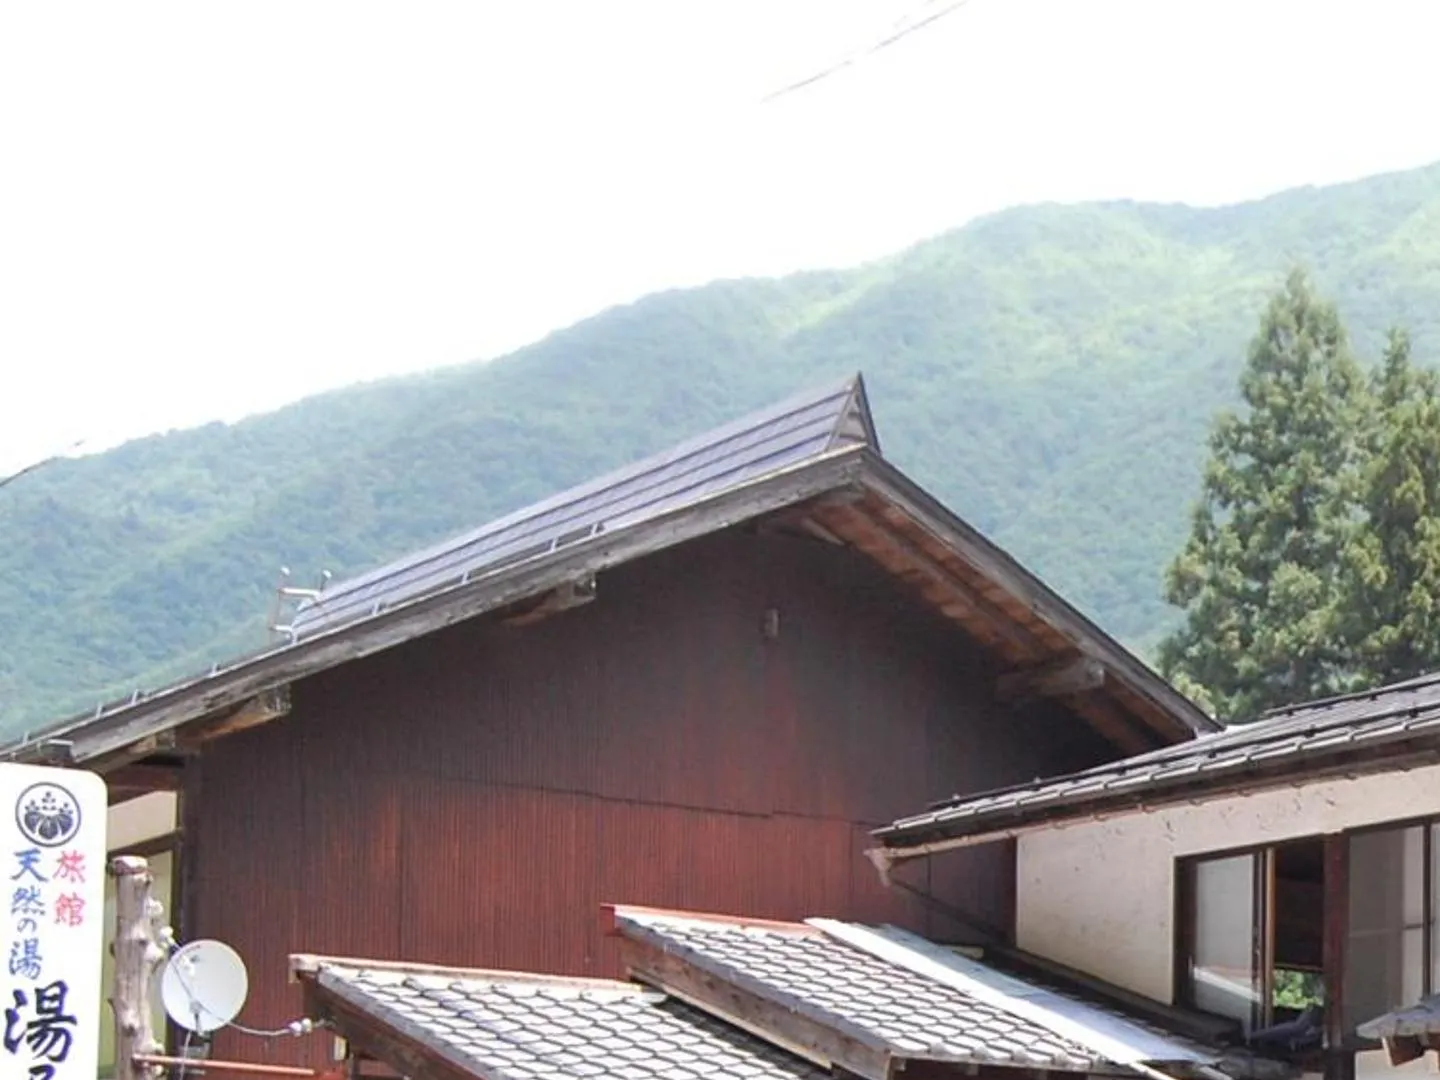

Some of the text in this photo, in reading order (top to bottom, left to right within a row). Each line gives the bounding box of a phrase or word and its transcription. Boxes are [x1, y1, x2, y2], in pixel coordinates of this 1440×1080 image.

[9, 849, 49, 980] 天然の湯
[53, 850, 87, 927] 旅館
